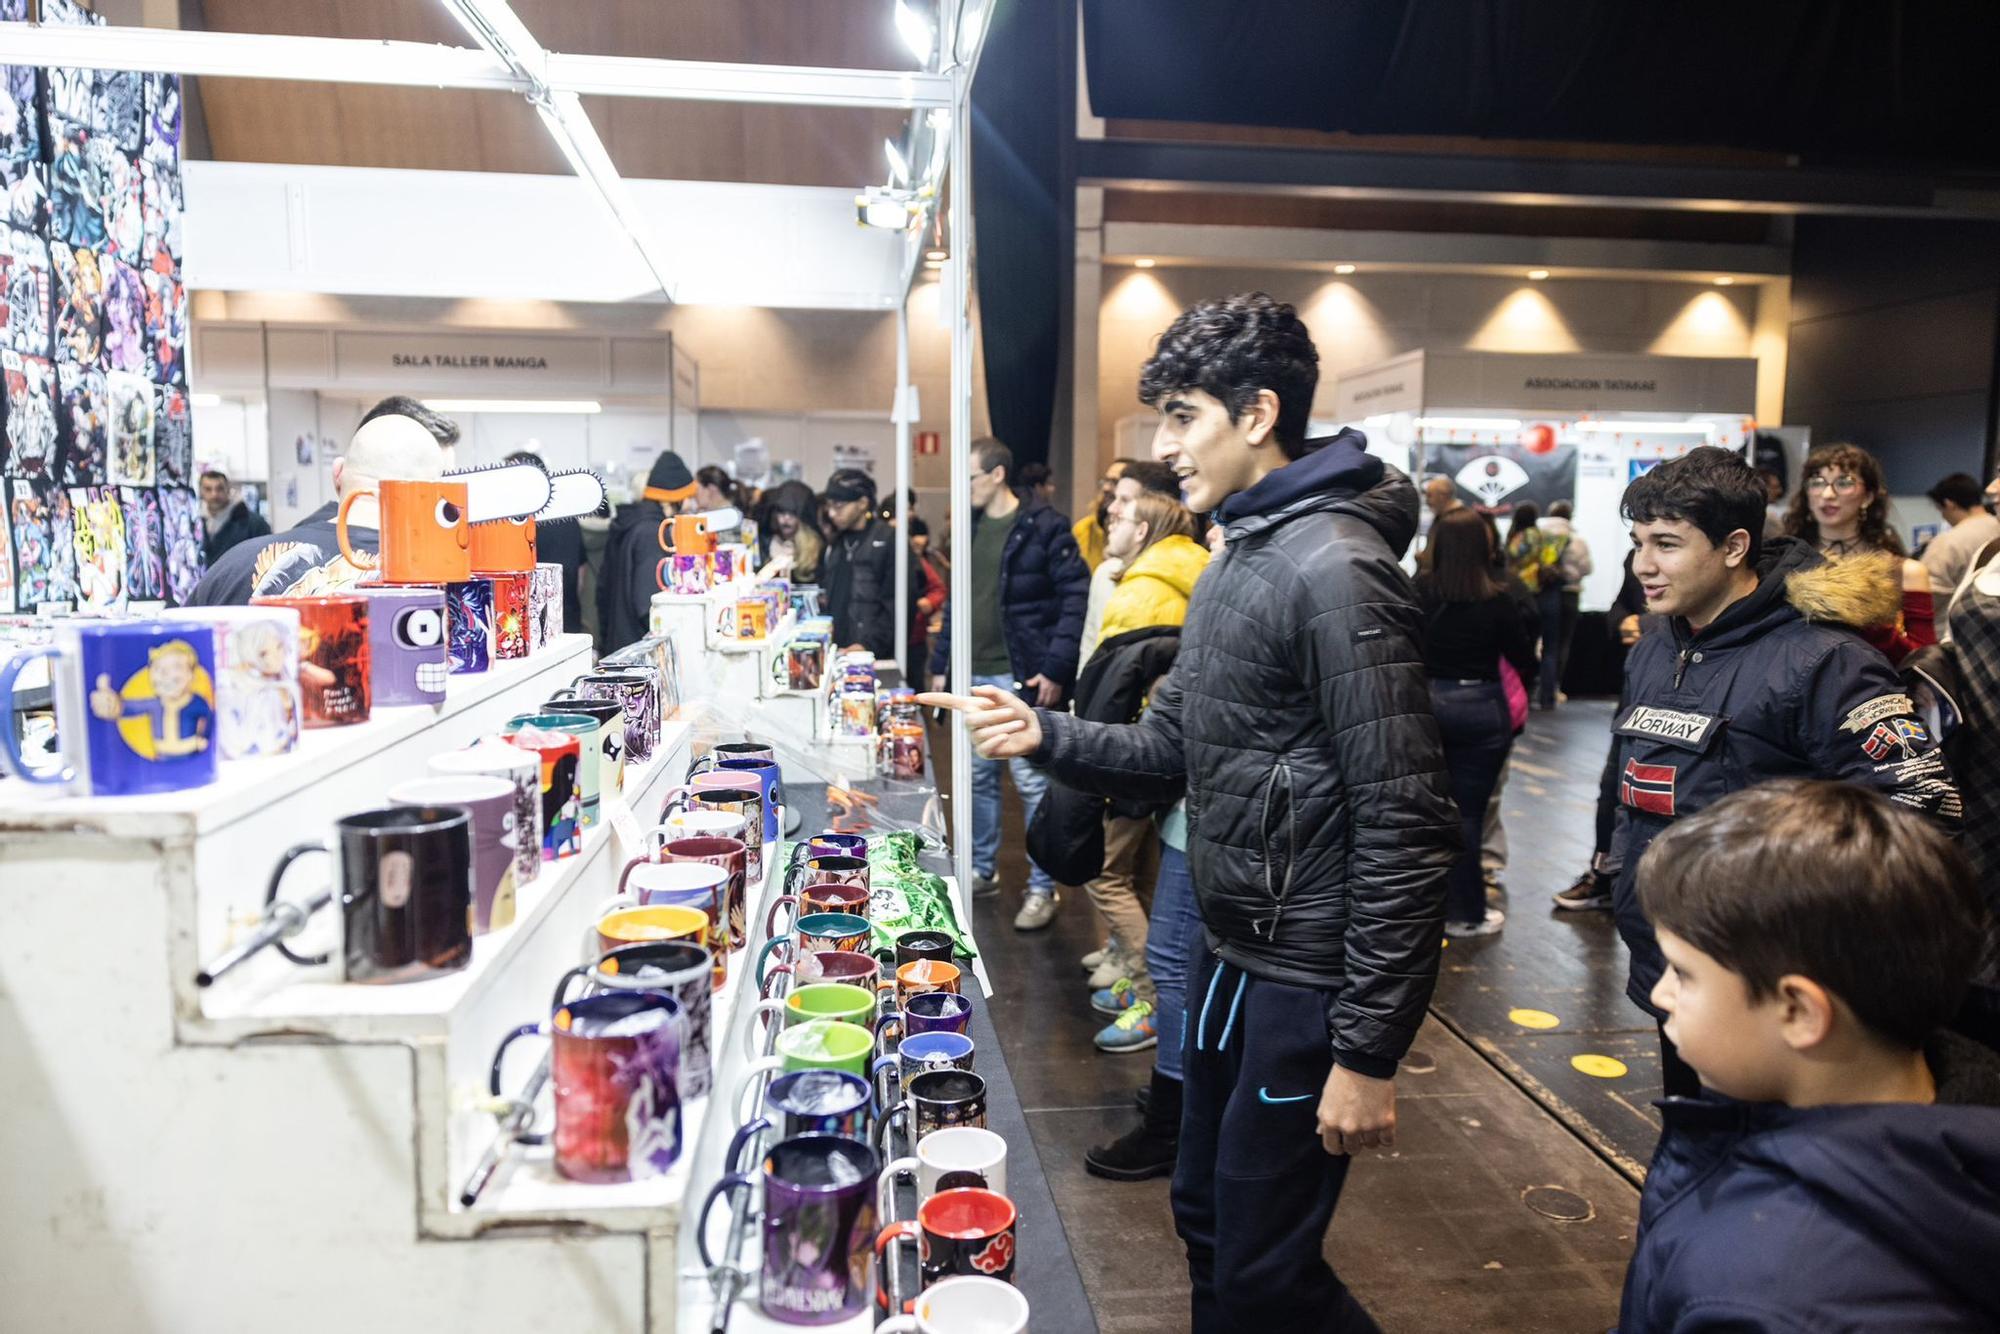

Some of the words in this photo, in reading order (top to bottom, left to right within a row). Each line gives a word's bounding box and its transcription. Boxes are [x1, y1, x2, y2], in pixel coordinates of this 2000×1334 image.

[392, 354, 431, 367] SALA
[435, 354, 489, 368] TALLER
[494, 356, 547, 369] MANGA
[1632, 709, 1700, 738] NORWAY
